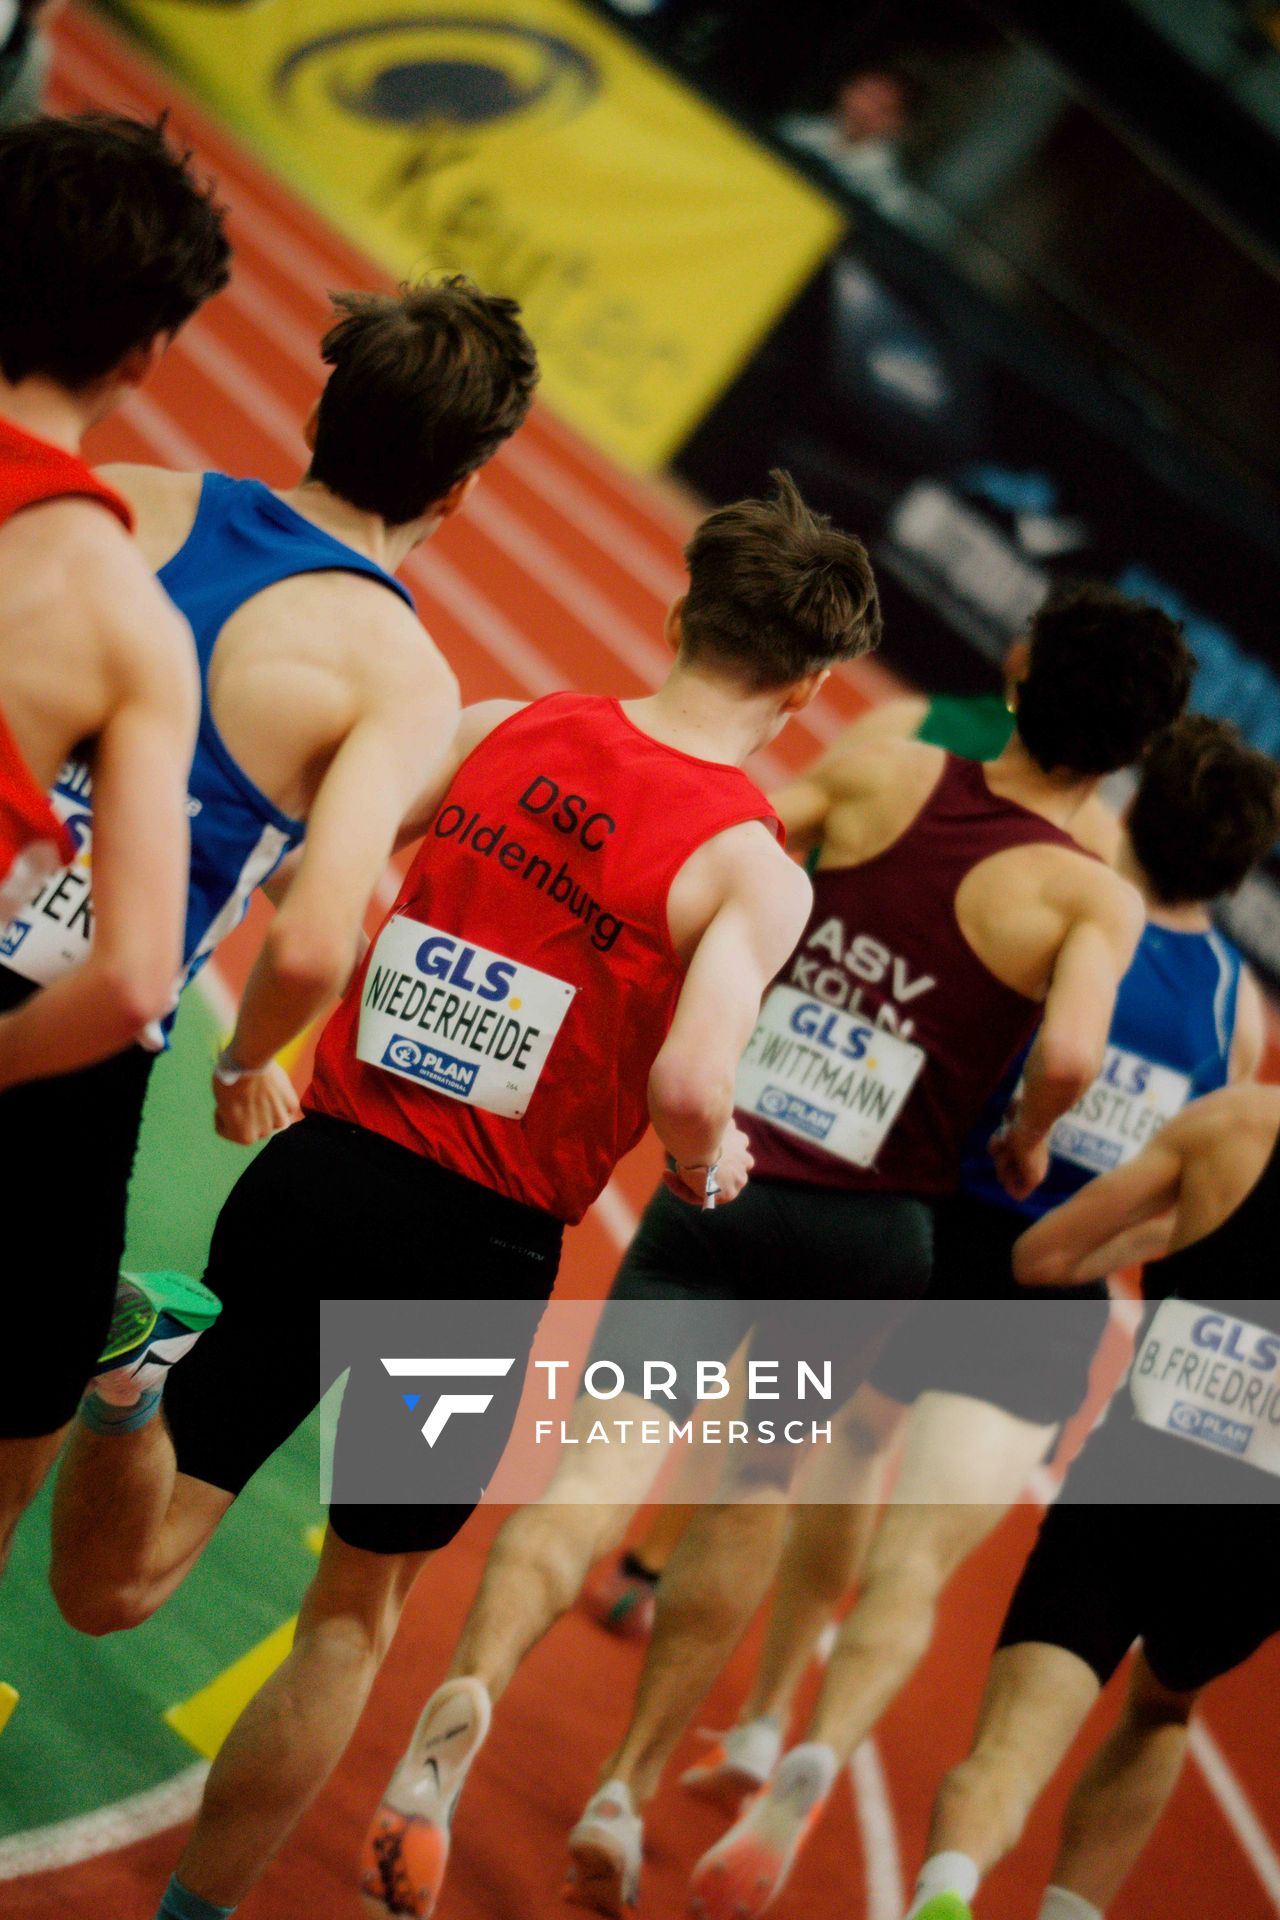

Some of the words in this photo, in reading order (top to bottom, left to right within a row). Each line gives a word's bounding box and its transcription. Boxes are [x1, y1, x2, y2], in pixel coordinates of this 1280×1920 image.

[517, 775, 617, 853] DSC
[434, 804, 624, 953] Oldenburg
[806, 917, 936, 1003] ASV
[364, 965, 540, 1070] NIEDERHEIDE
[419, 1067, 467, 1092] INTERNATIONAL
[422, 1052, 474, 1085] PLAN
